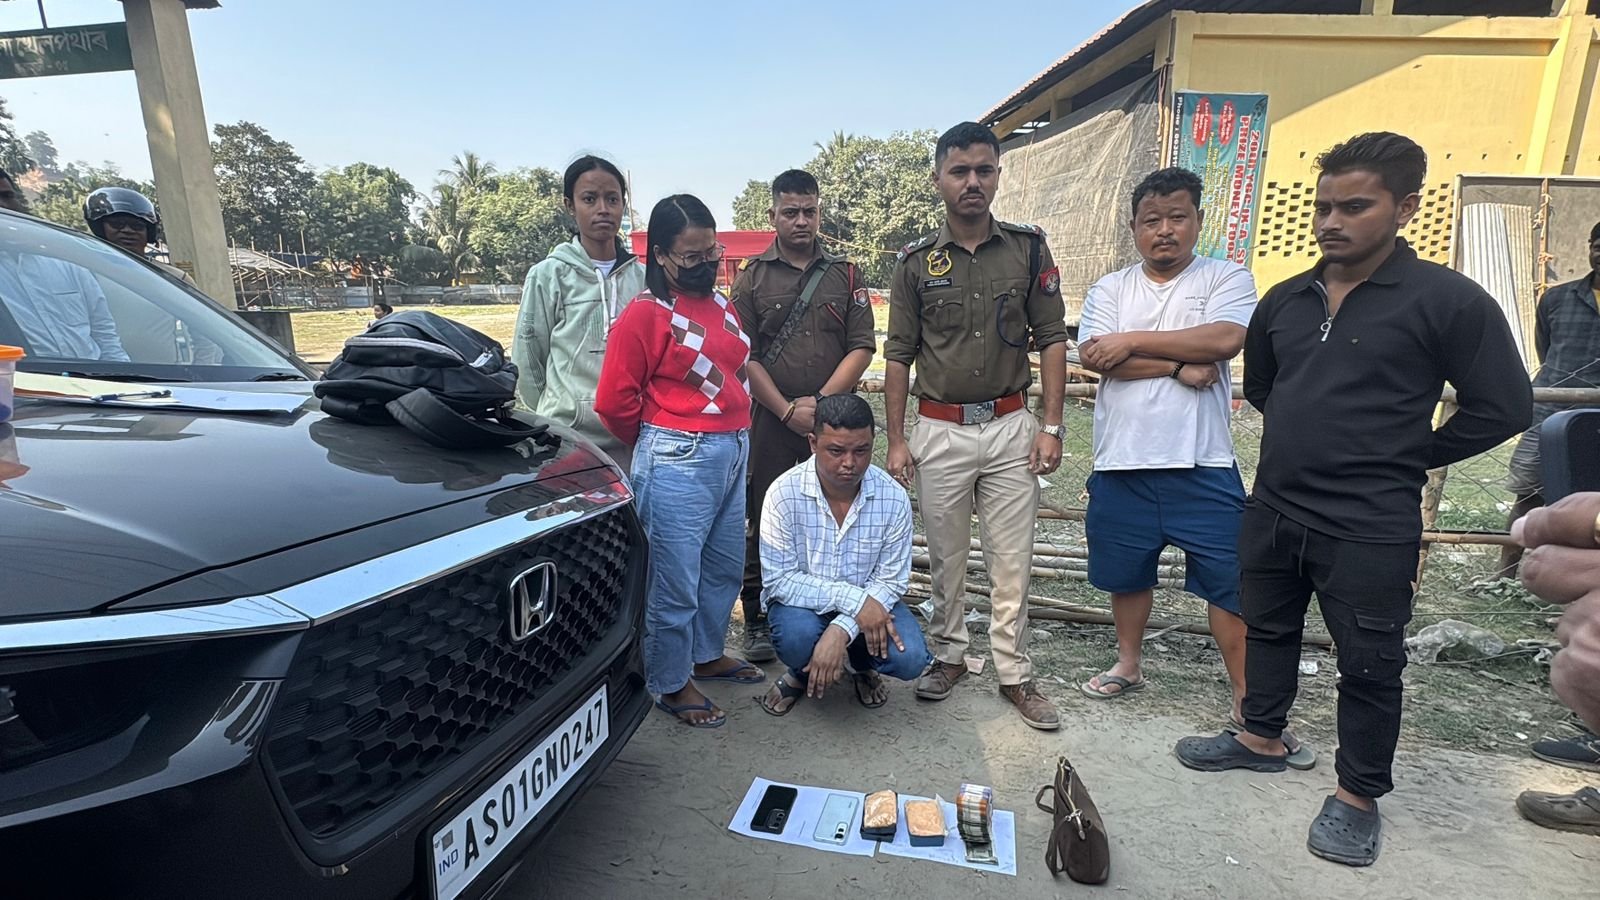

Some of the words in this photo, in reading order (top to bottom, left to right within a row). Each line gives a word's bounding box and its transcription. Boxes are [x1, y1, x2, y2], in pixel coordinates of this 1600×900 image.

[1236, 115, 1251, 160] PRIZE
[1229, 164, 1245, 219] MONEY
[464, 698, 603, 871] AS01GN0247
[438, 848, 459, 876] IND
